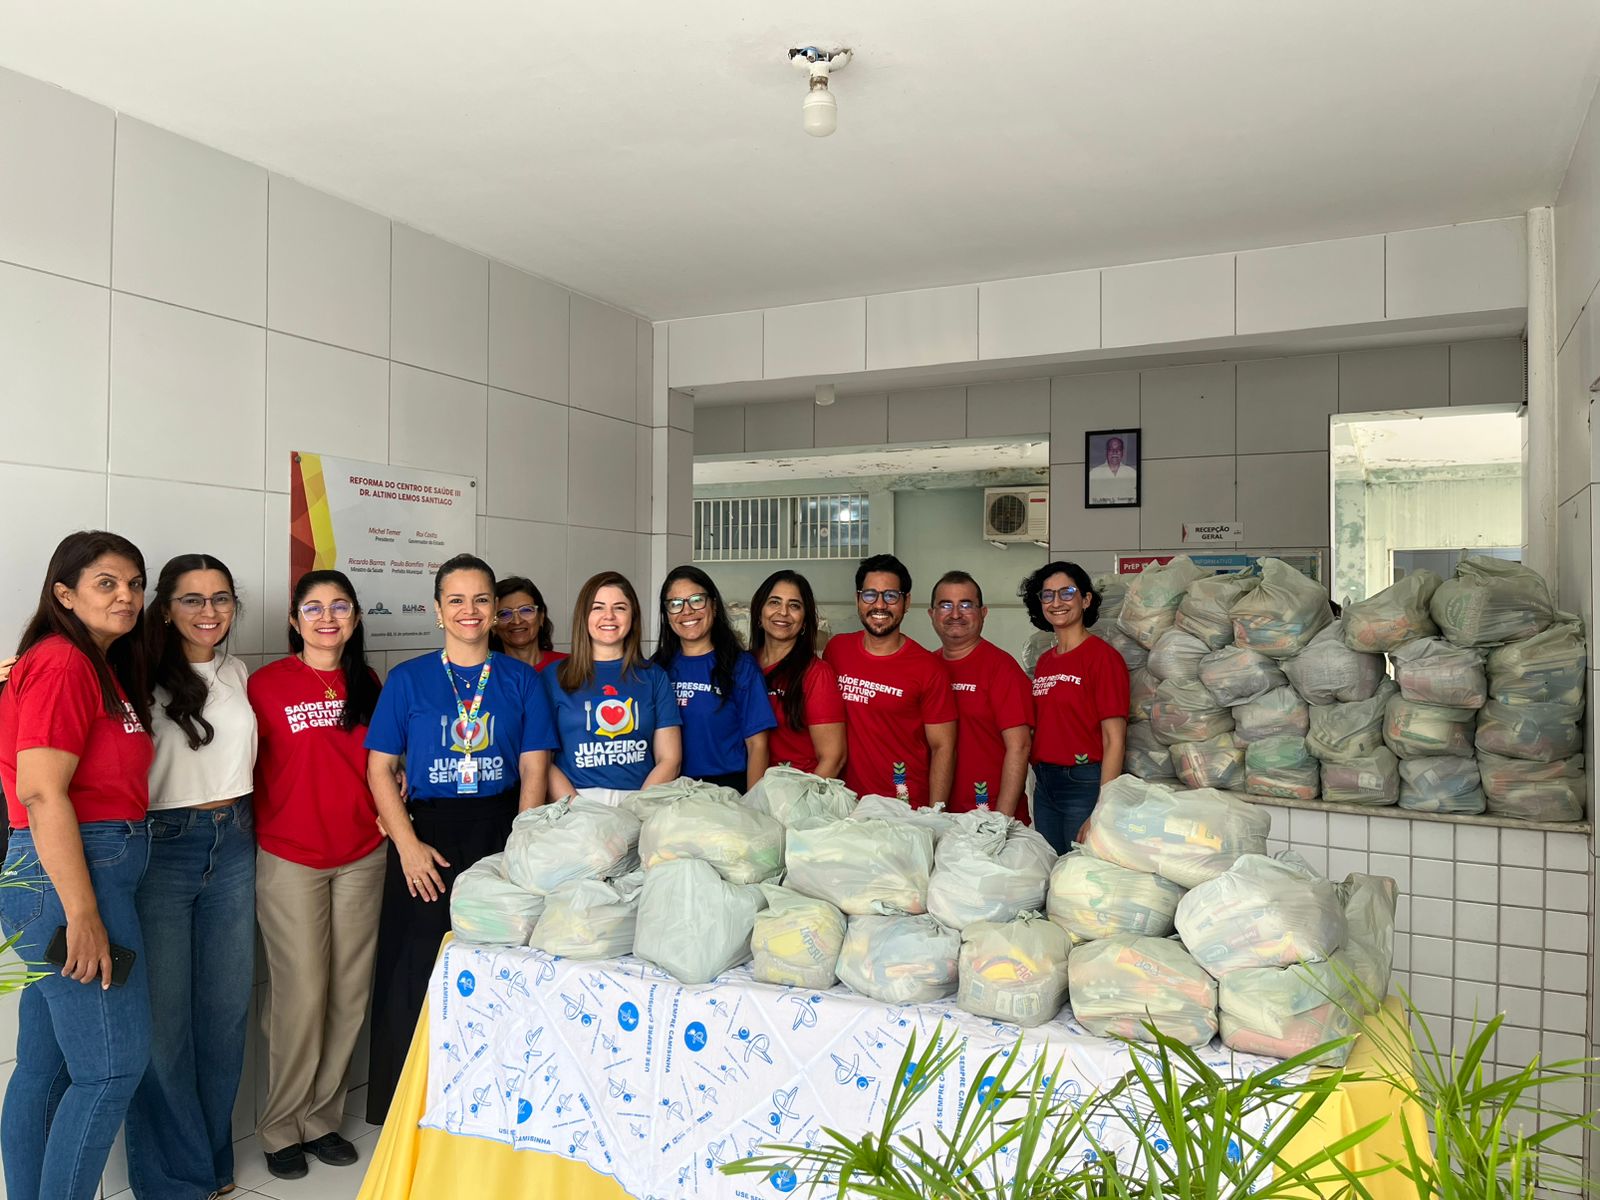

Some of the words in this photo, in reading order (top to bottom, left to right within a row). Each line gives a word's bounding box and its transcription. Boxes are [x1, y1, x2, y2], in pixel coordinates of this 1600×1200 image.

[349, 476, 383, 488] REFORMA
[384, 481, 395, 489] DO
[396, 482, 422, 492] CENTRO
[423, 485, 433, 493] DE
[433, 486, 454, 496] SAÚDE
[359, 488, 371, 496] DR.
[372, 490, 397, 499] ALTINO
[398, 493, 420, 502] LEMOS
[421, 496, 453, 506] SANTIAGO
[368, 527, 386, 535] Michel
[386, 528, 401, 536] Temer
[348, 557, 368, 565] Ricardo
[369, 558, 386, 566] Barros
[390, 559, 404, 567] Paulo
[837, 674, 859, 686] AÚDE
[859, 679, 904, 697] PRESENTE
[843, 684, 876, 698] FUTURO
[951, 683, 977, 692] SENTE
[675, 690, 695, 698] URO
[842, 692, 869, 704] GENTE
[284, 701, 324, 715] SAÚDE
[324, 700, 345, 709] PRE
[287, 713, 306, 724] NO
[290, 722, 309, 734] DA
[574, 740, 648, 756] JUAZEIRO
[428, 756, 504, 772] JUAIRO
[575, 754, 606, 768] SEM
[608, 751, 646, 765] FOME
[669, 998, 679, 1029] SEMPRE
[646, 1024, 654, 1055] SEMPRE
[665, 1029, 674, 1073] CAMISINHA
[937, 1085, 945, 1119] SEMPRE
[735, 1190, 749, 1199] USE
